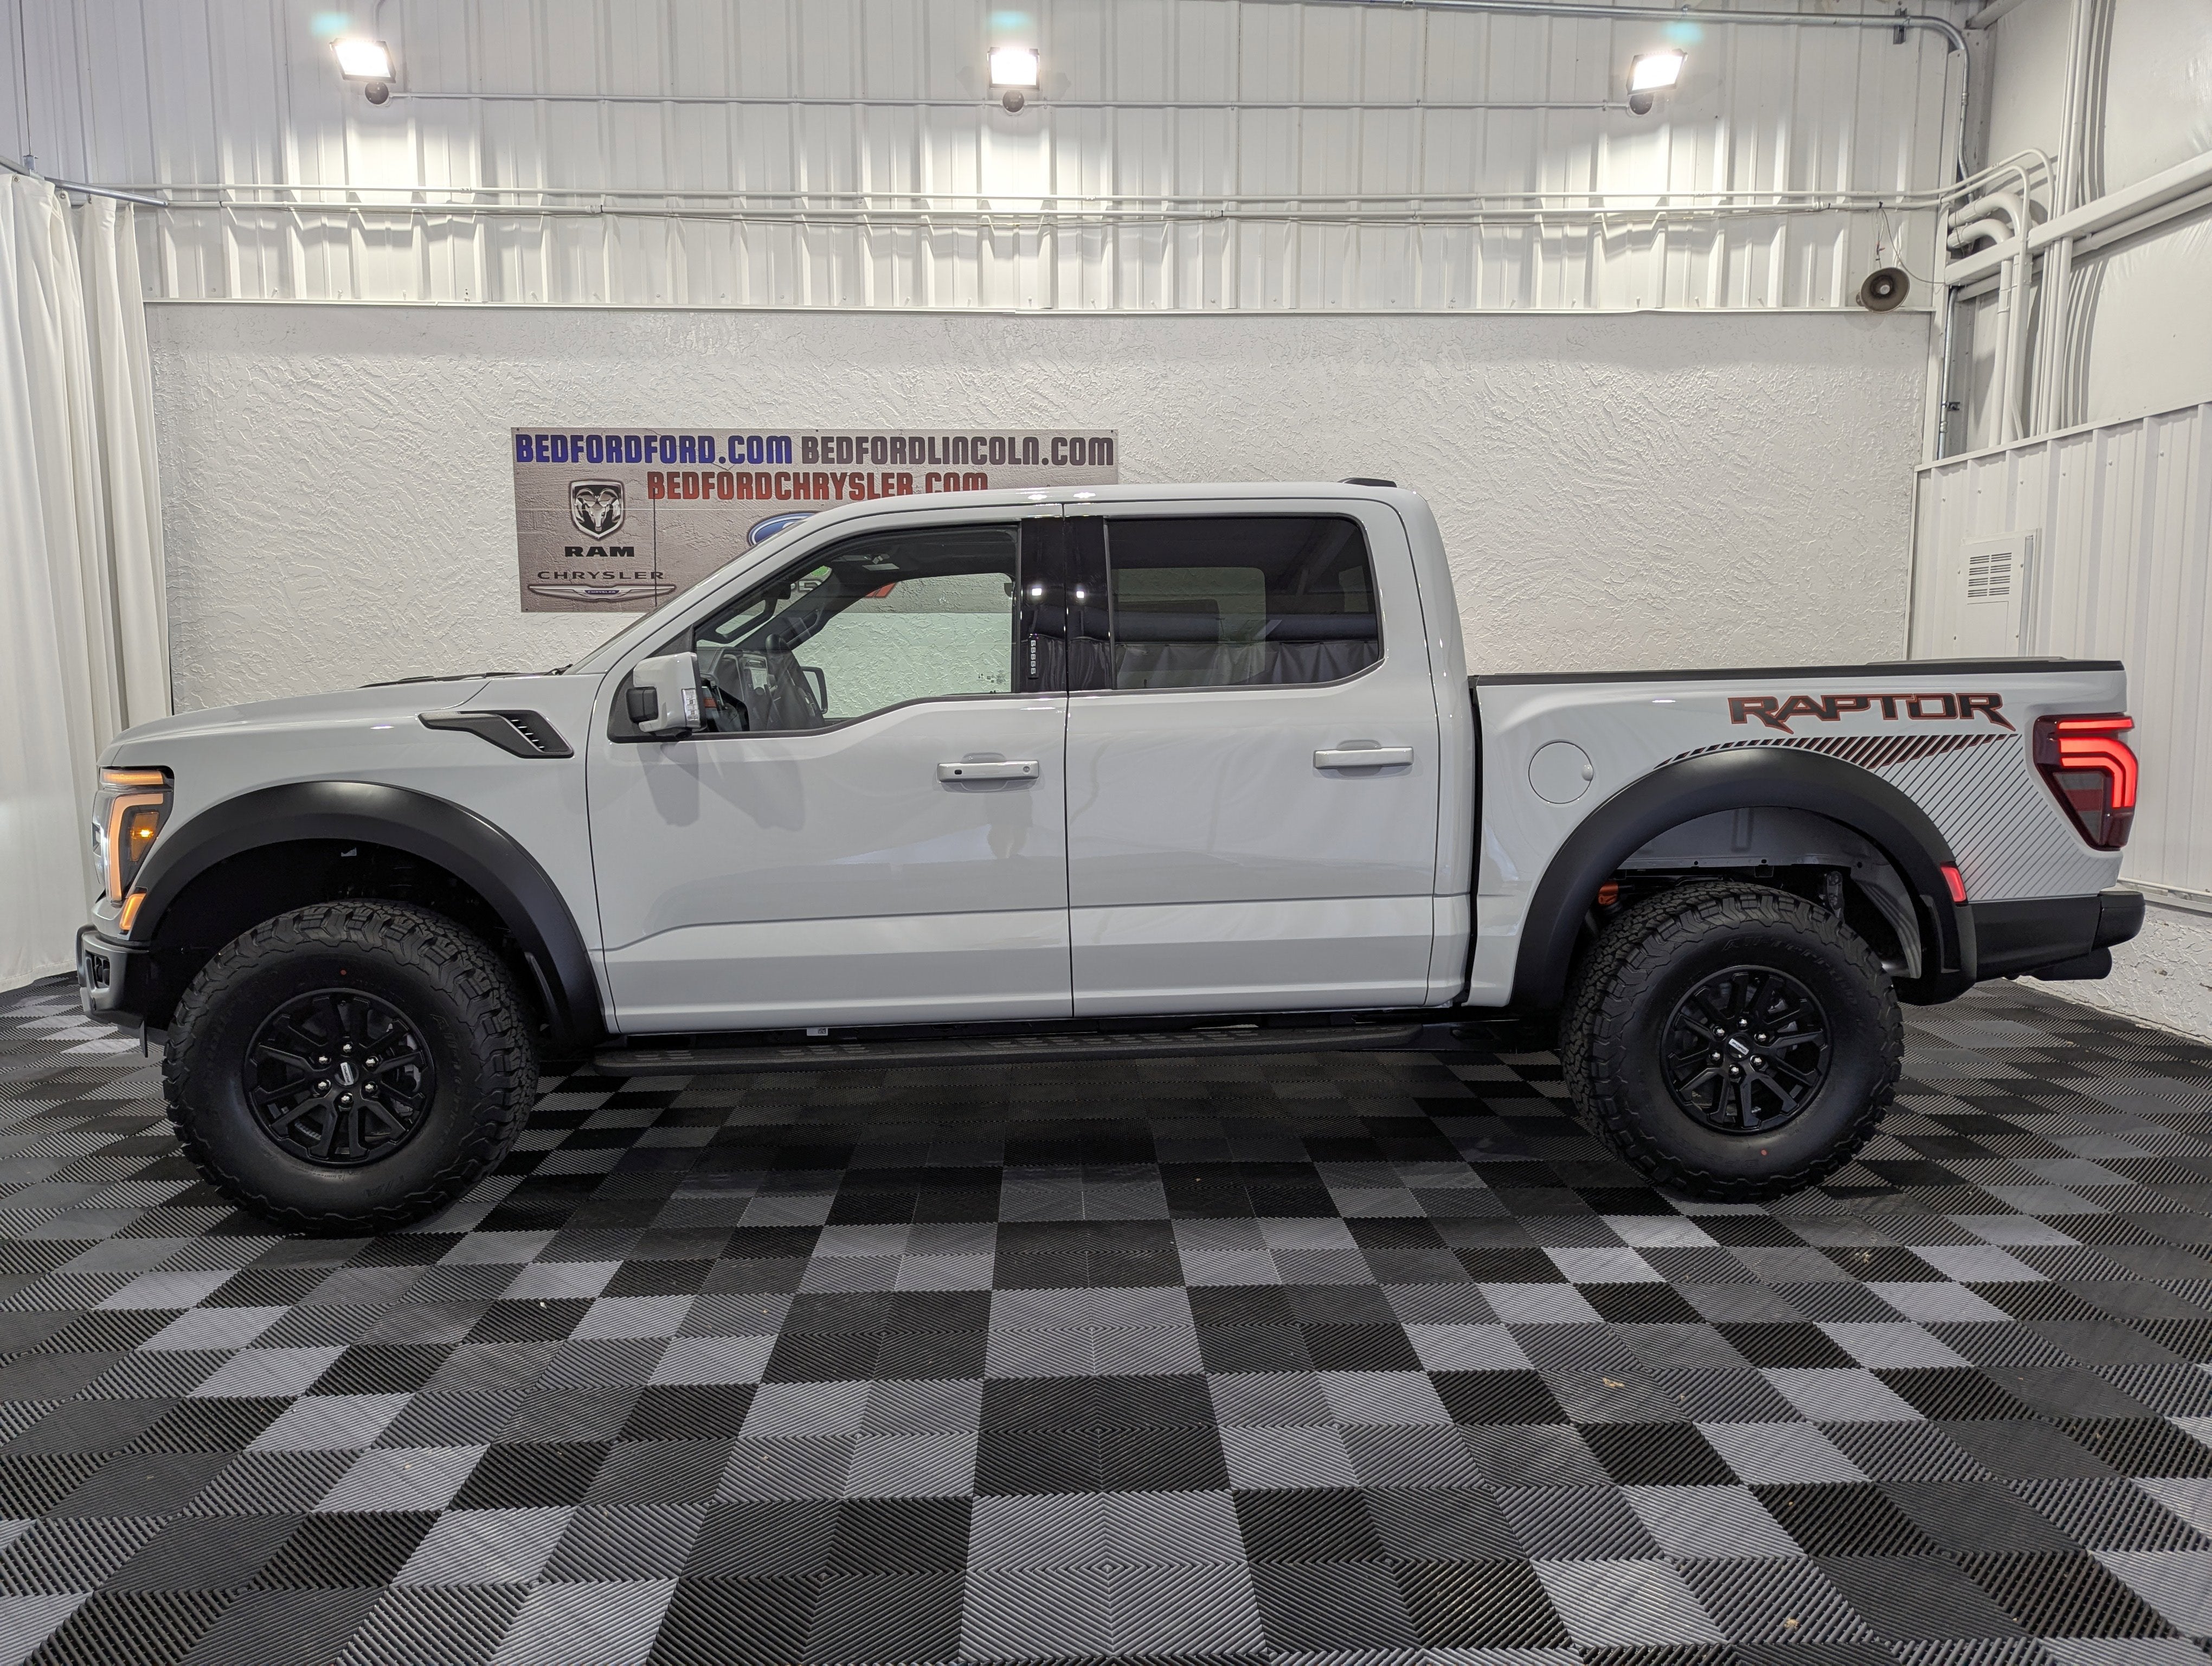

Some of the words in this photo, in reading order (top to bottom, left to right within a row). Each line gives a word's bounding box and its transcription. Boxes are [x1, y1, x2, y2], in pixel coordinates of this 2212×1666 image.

[516, 434, 792, 464] BEDFORDFORD.COM
[801, 435, 1114, 466] BEDFORDLINCOLN.COM
[647, 471, 988, 500] BEDFORDCHRYSLERCOM
[564, 546, 635, 558] RAM
[537, 571, 665, 580] CHRYSLER
[1728, 693, 2016, 734] RAPTOR
[1732, 1042, 1746, 1053] FORD
[343, 1065, 351, 1083] FORD
